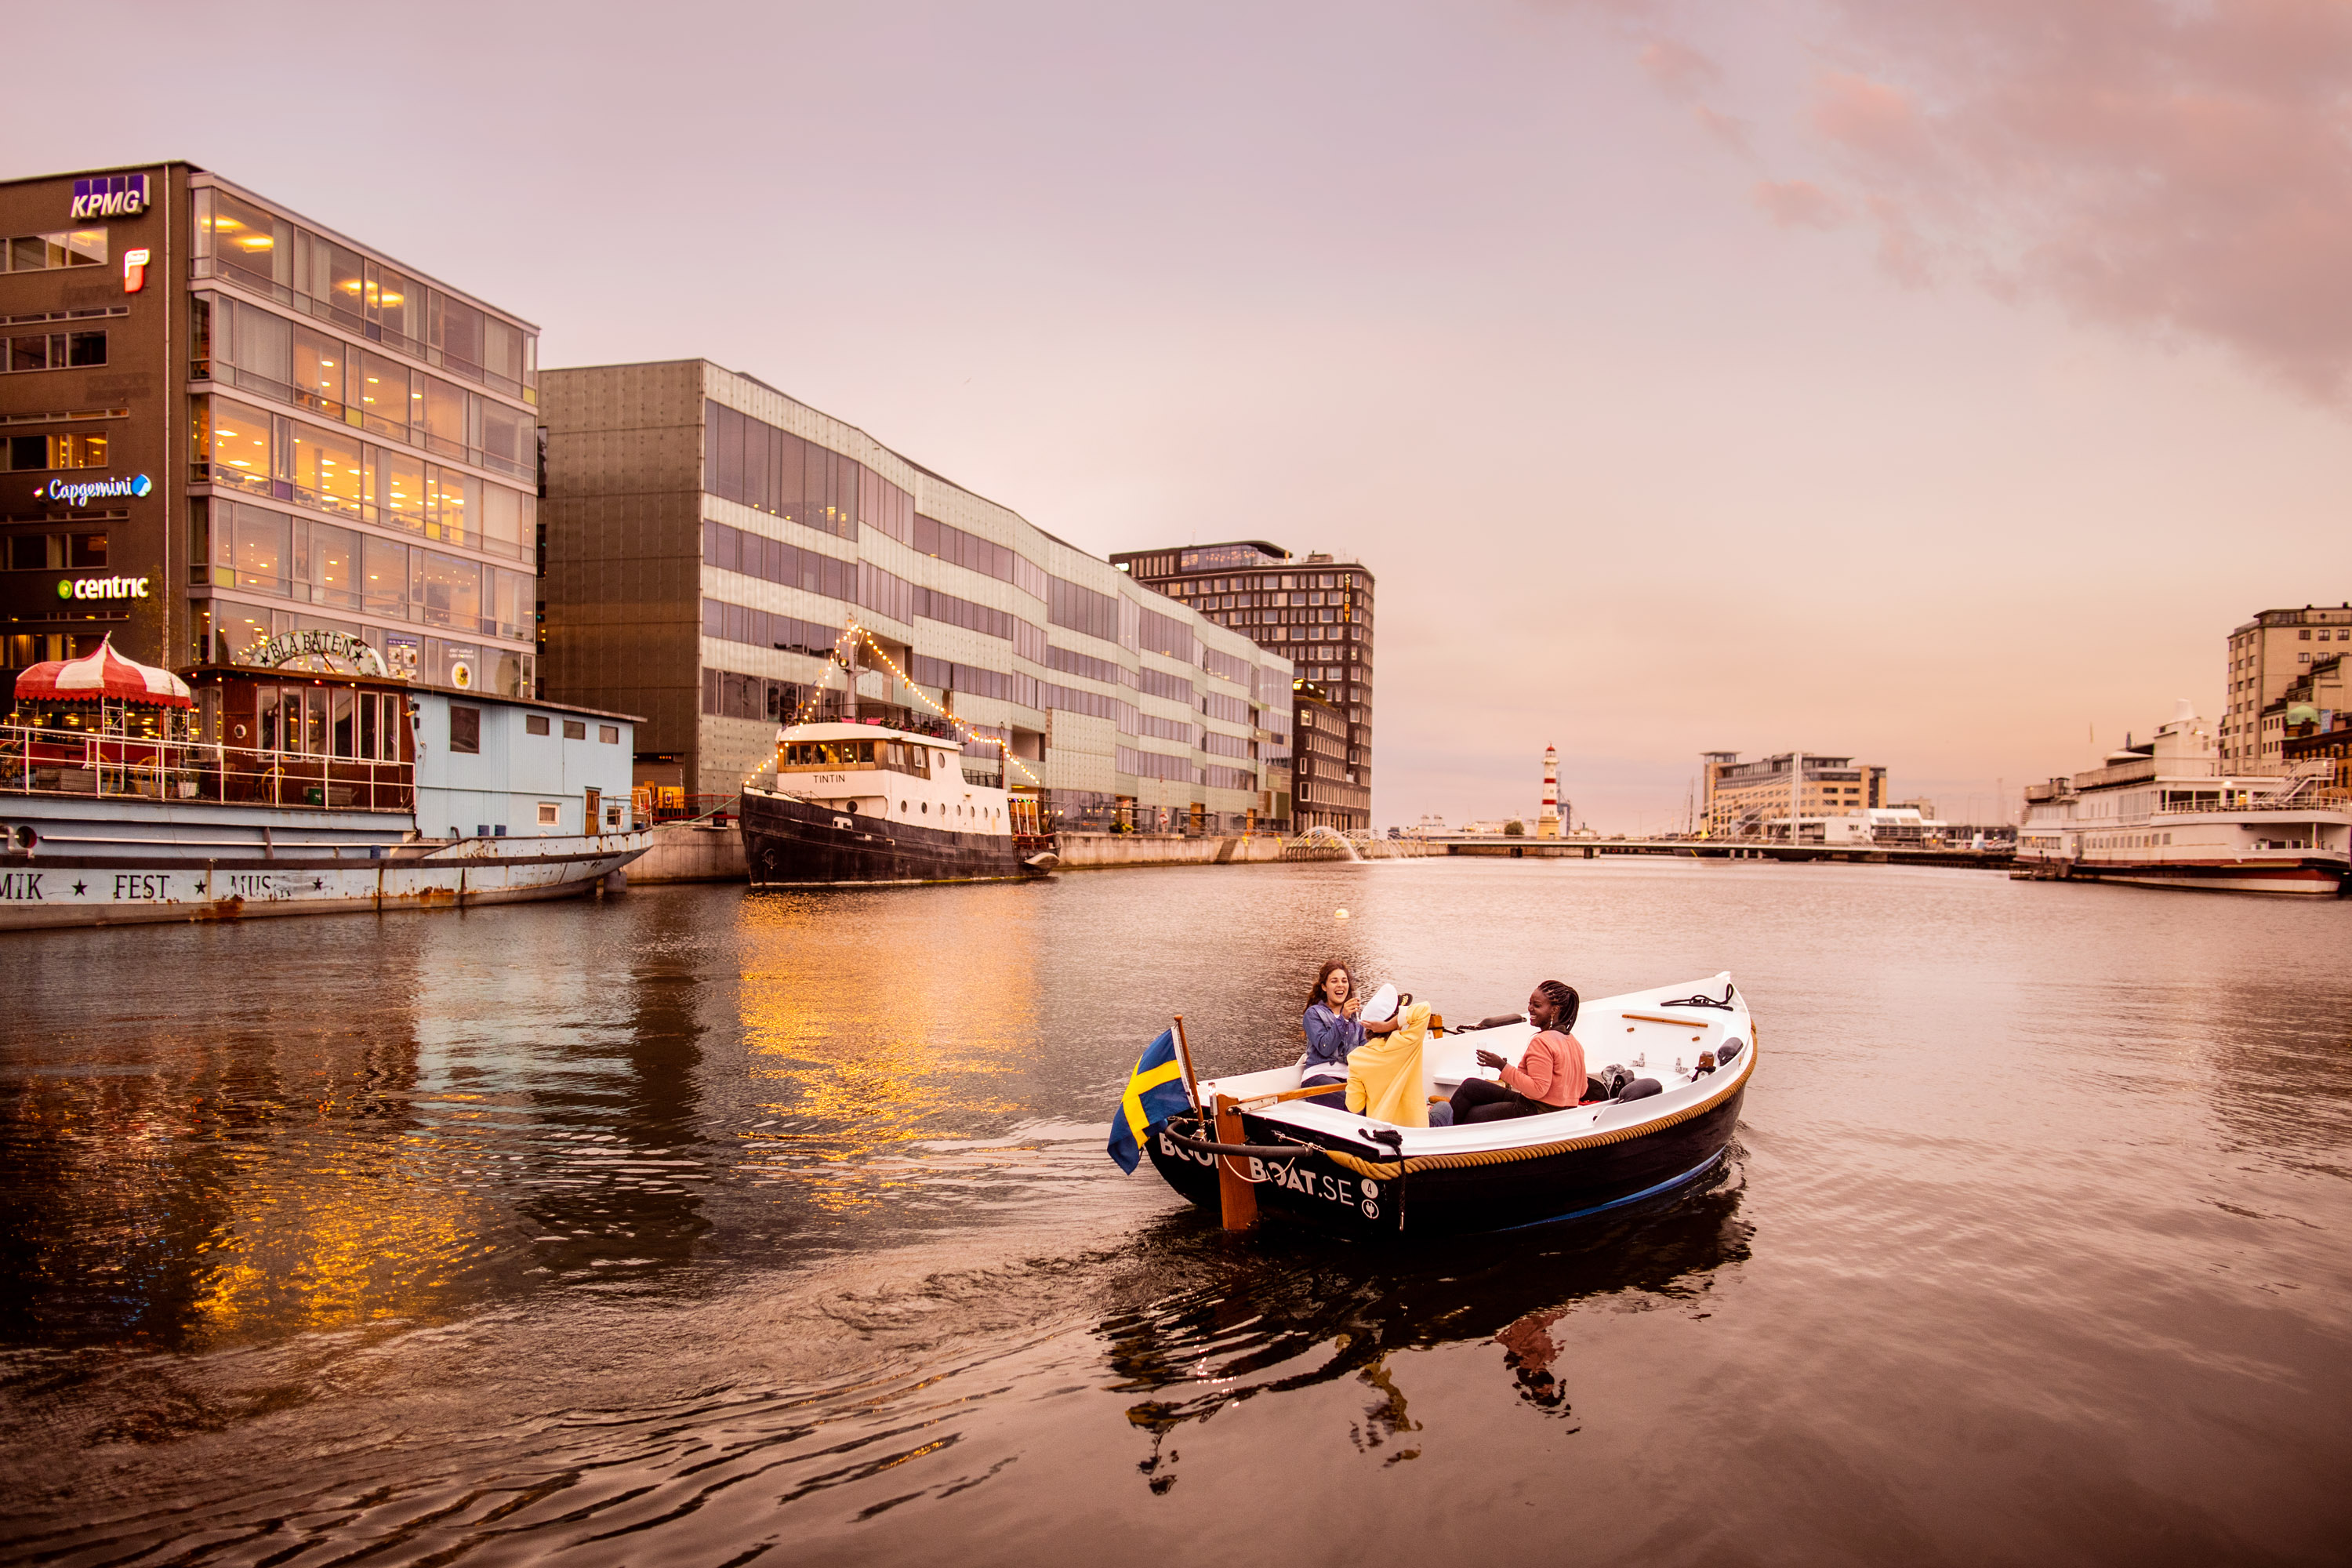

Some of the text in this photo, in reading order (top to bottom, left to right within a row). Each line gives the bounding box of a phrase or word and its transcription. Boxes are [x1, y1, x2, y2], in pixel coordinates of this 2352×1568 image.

[71, 191, 140, 218] KPMG
[49, 477, 132, 507] Capgemini
[74, 575, 149, 600] centric
[813, 775, 845, 783] TINTIN
[115, 875, 170, 899] FEST
[1367, 1183, 1373, 1195] 4
